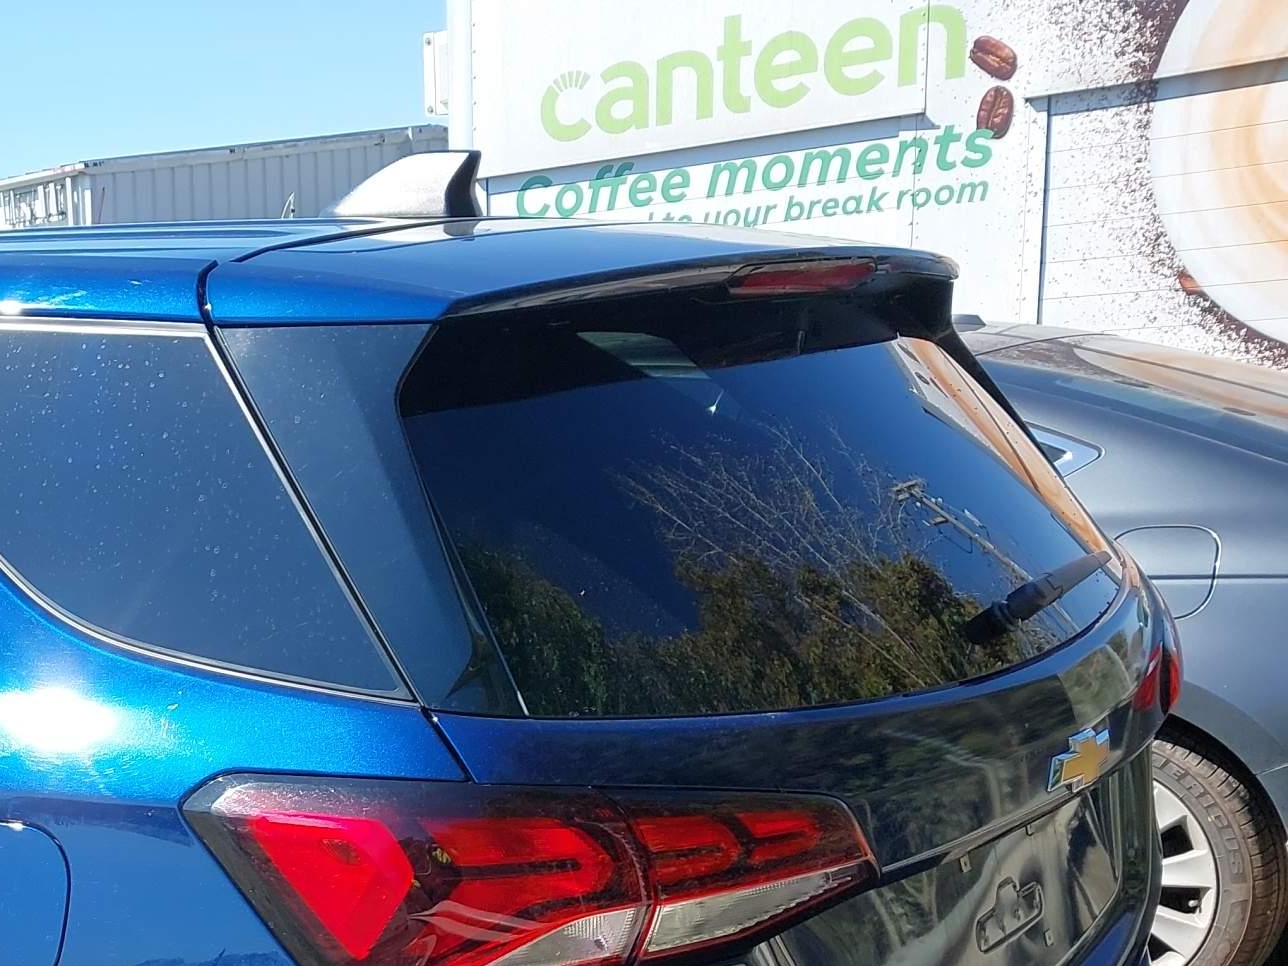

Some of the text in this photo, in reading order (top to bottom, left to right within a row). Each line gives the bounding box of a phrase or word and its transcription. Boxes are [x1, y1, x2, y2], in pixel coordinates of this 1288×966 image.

[541, 3, 966, 142] canteen
[516, 124, 996, 217] Coffee moments
[783, 184, 889, 222] break
[894, 178, 989, 210] room
